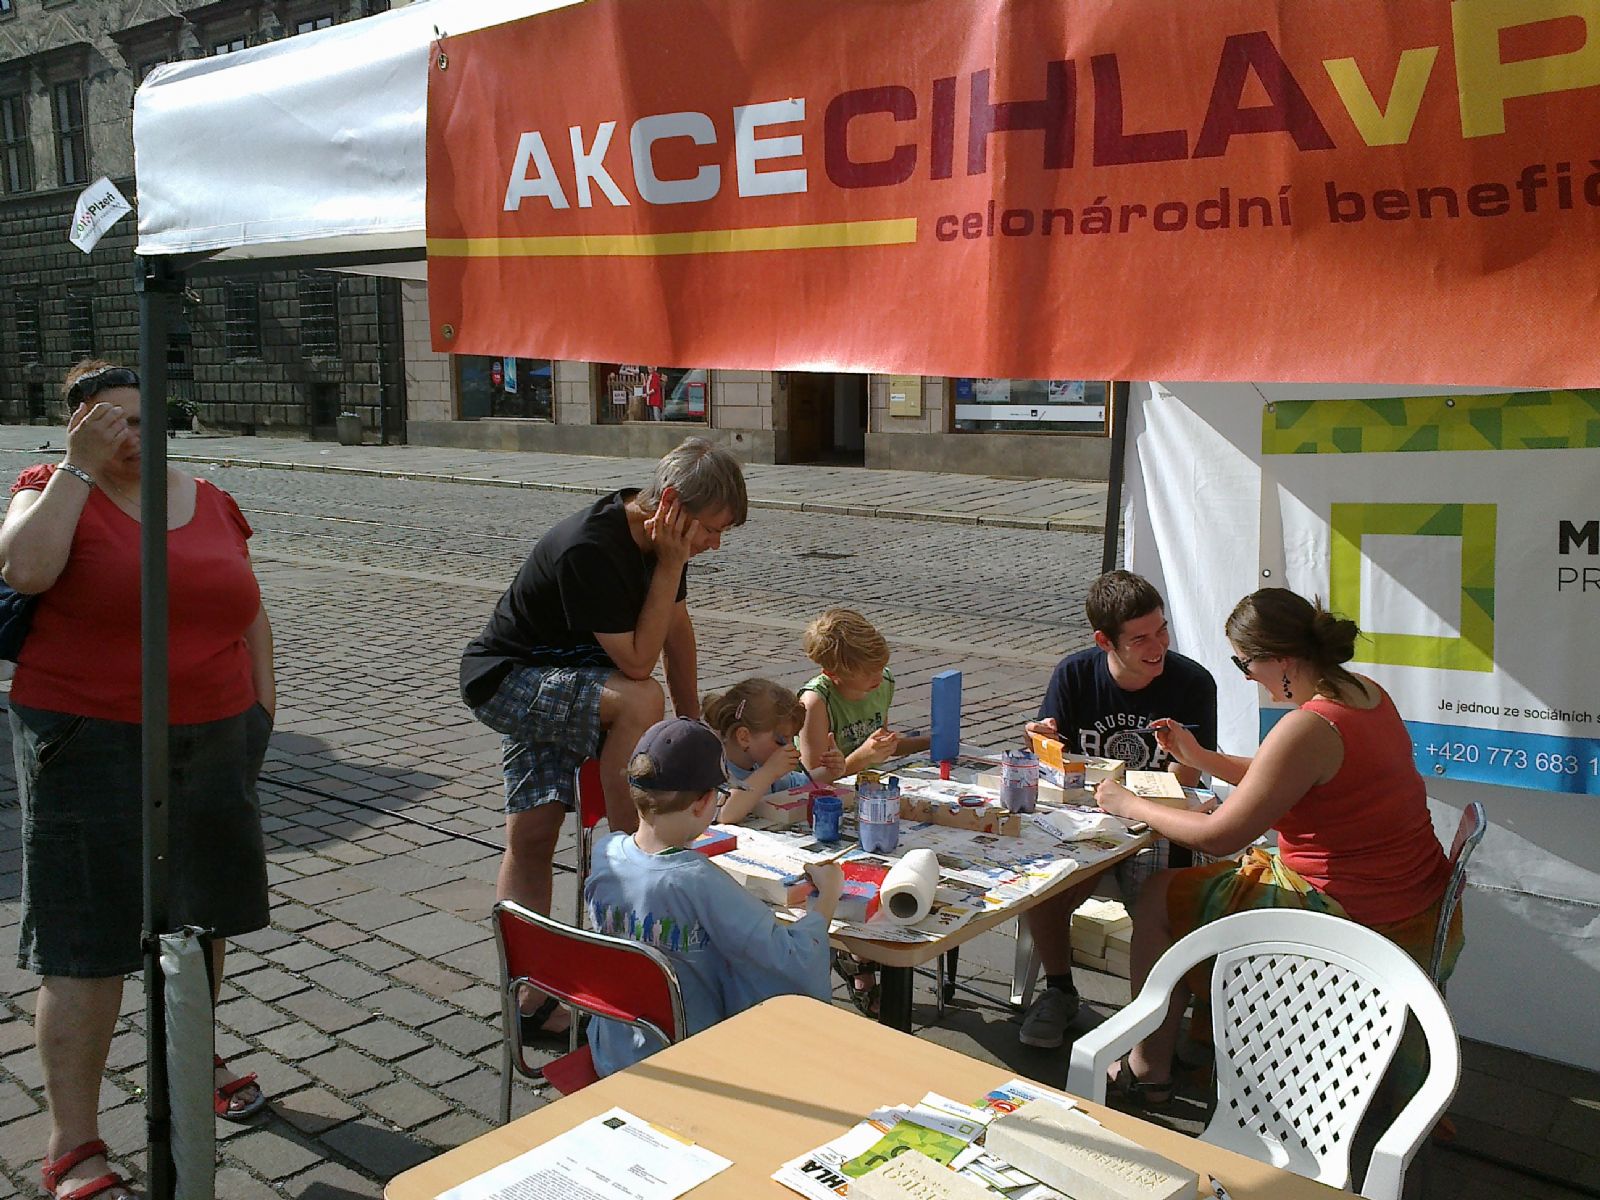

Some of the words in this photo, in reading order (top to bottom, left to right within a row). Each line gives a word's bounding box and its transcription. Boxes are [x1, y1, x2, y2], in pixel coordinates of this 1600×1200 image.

[934, 184, 1293, 242] celonárodní
[1094, 712, 1153, 734] RUSSE
[1438, 699, 1453, 711] Je
[1456, 700, 1500, 715] jednou
[1504, 706, 1520, 718] ze
[1524, 708, 1592, 724] sociálních
[1426, 741, 1479, 763] +420
[1487, 746, 1528, 769] 773
[1535, 752, 1579, 775] 683
